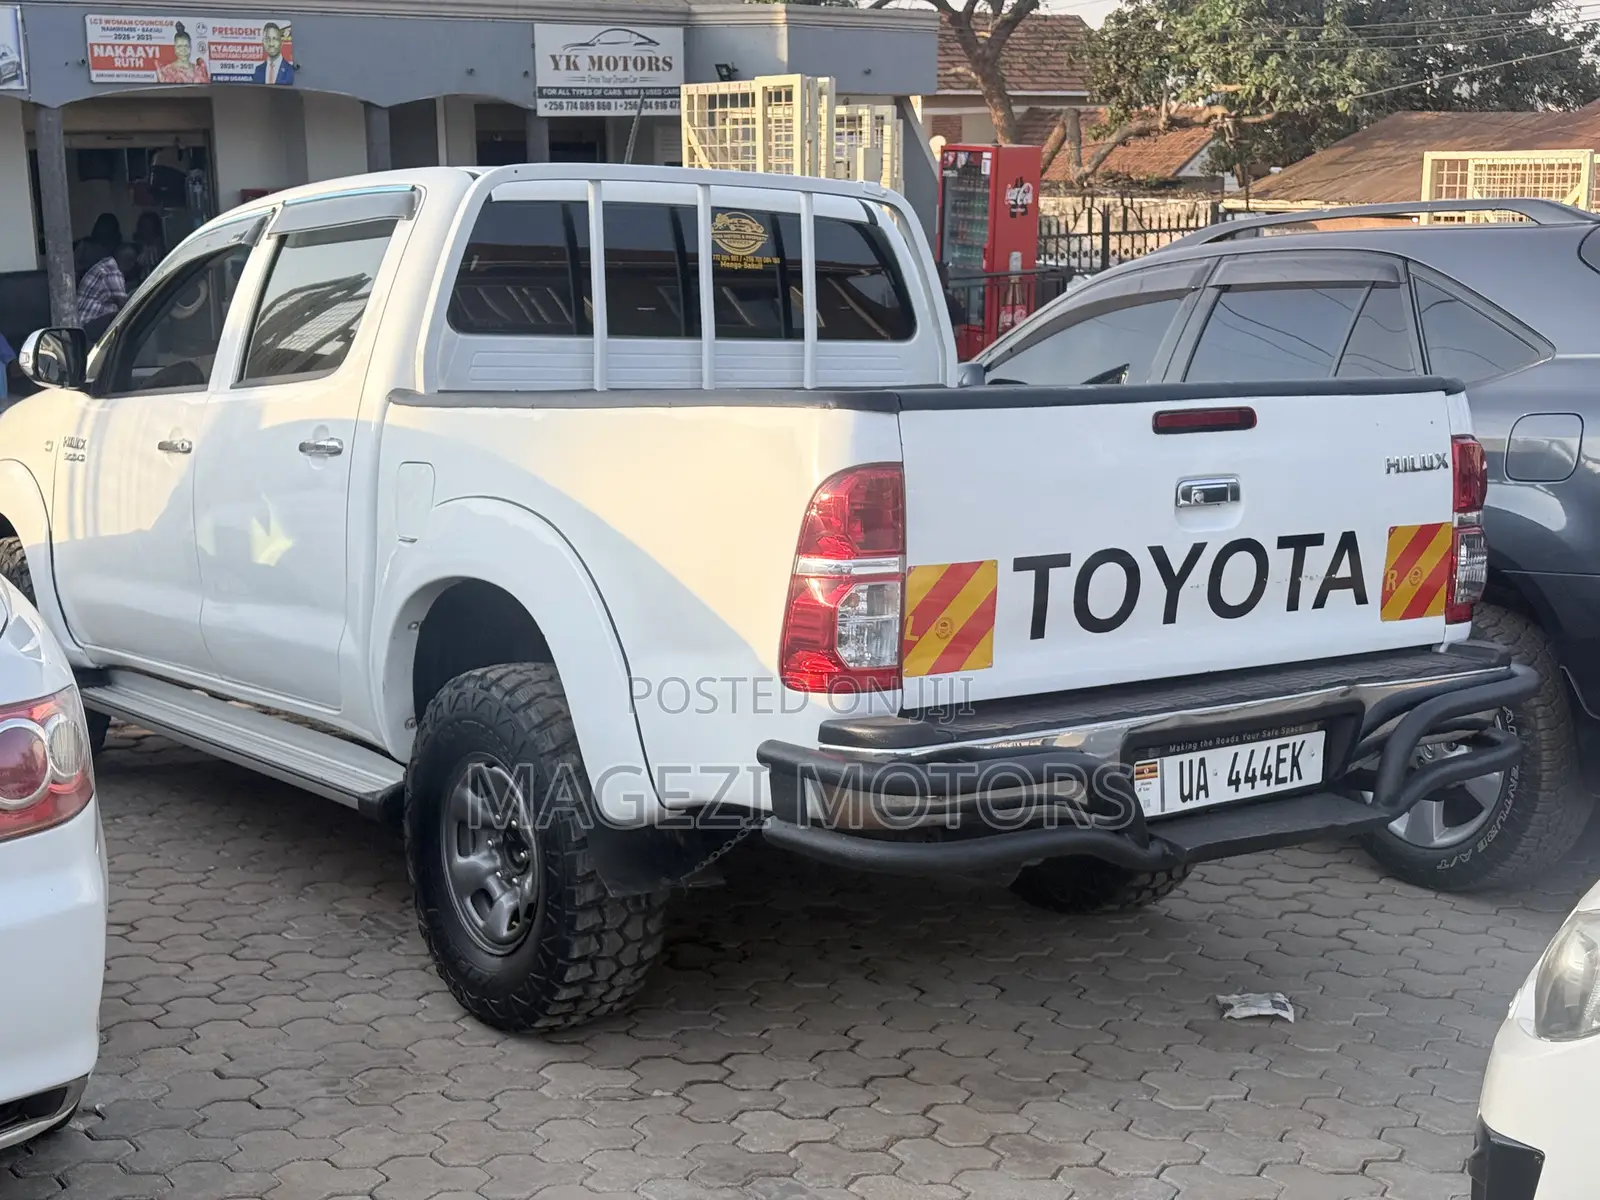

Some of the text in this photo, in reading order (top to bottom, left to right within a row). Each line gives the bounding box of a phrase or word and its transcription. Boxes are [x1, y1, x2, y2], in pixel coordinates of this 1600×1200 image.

[212, 26, 262, 36] PRESIDENT
[92, 44, 160, 58] NAKAAYI
[114, 57, 144, 68] RUTH
[549, 54, 674, 72] YK MOTORS
[542, 88, 558, 96] FOR
[558, 88, 571, 96] ALL
[571, 88, 593, 96] TYPES
[624, 88, 639, 97] NEW
[543, 101, 564, 111] +256
[1385, 452, 1449, 474] HILUX
[1012, 530, 1369, 641] TOYOTA
[1386, 569, 1398, 591] R
[904, 615, 920, 641] L
[1169, 725, 1303, 753] Making the Roads Your Safe Space
[1178, 739, 1306, 804] UA 444EK
[1436, 848, 1473, 869] A/T
